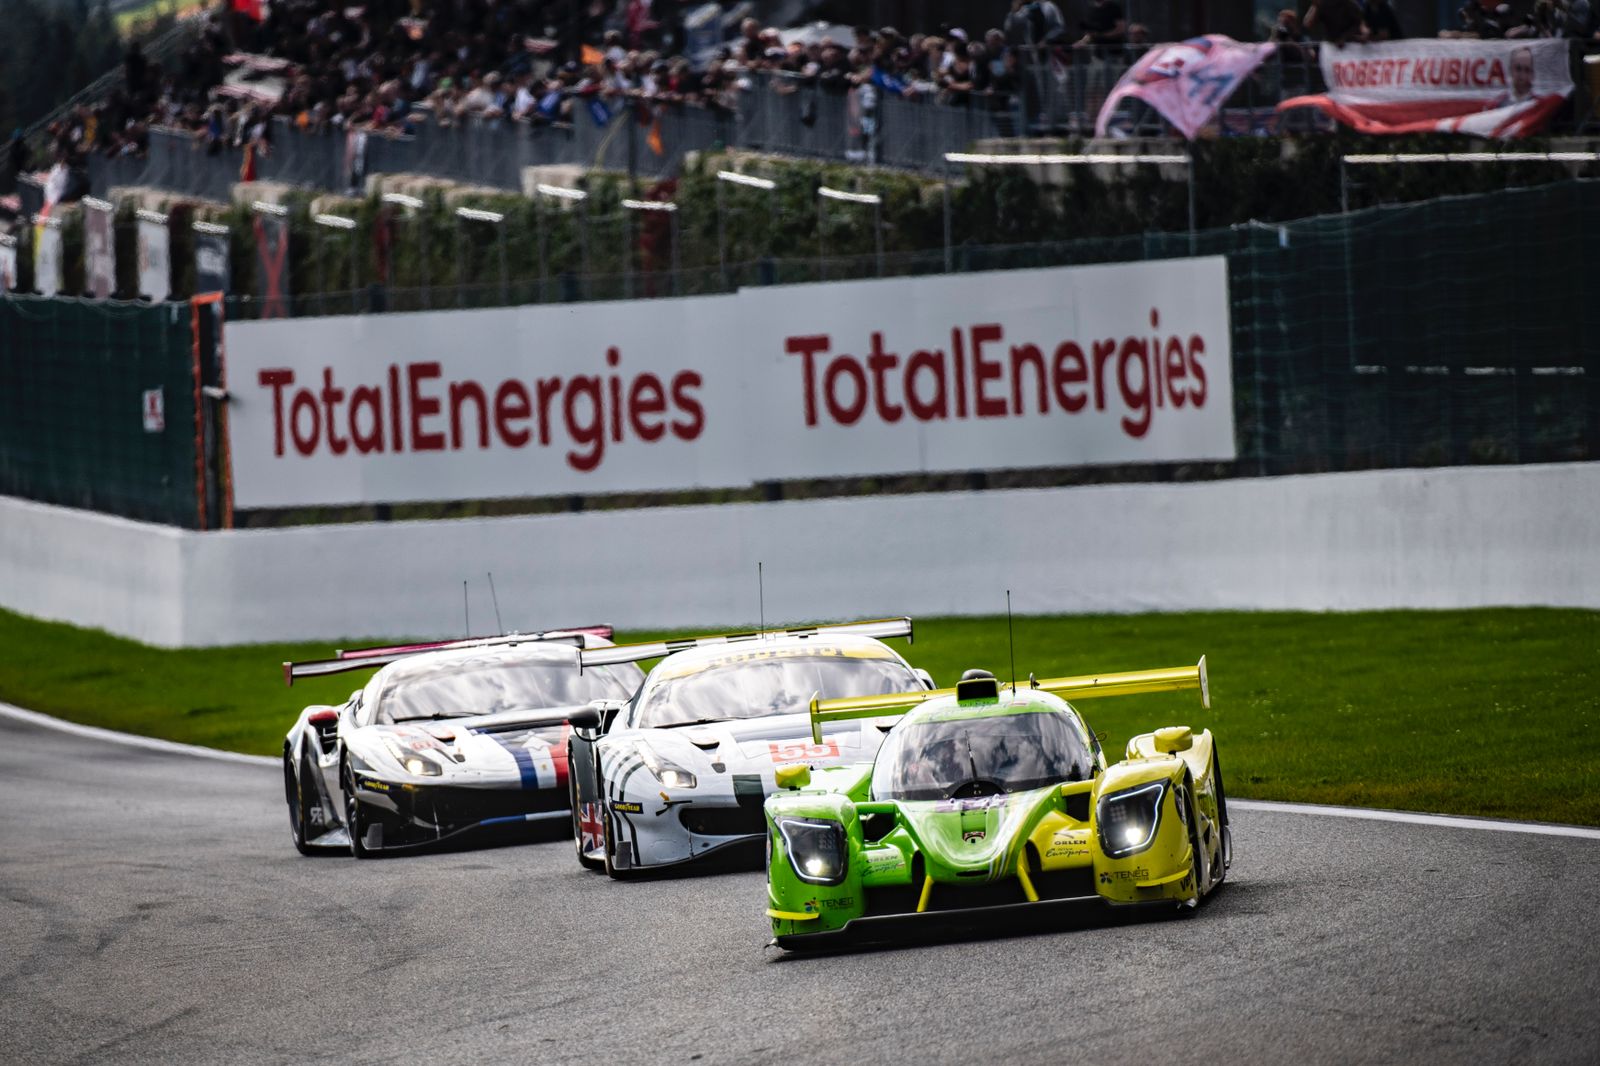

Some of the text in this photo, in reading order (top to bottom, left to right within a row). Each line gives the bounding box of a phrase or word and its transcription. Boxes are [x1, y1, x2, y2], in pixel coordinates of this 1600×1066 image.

[1332, 57, 1507, 88] ROBERT KUBICA
[258, 345, 705, 473] TotalEnergies
[784, 307, 1207, 439] TotalEnergies
[775, 742, 833, 760] 55
